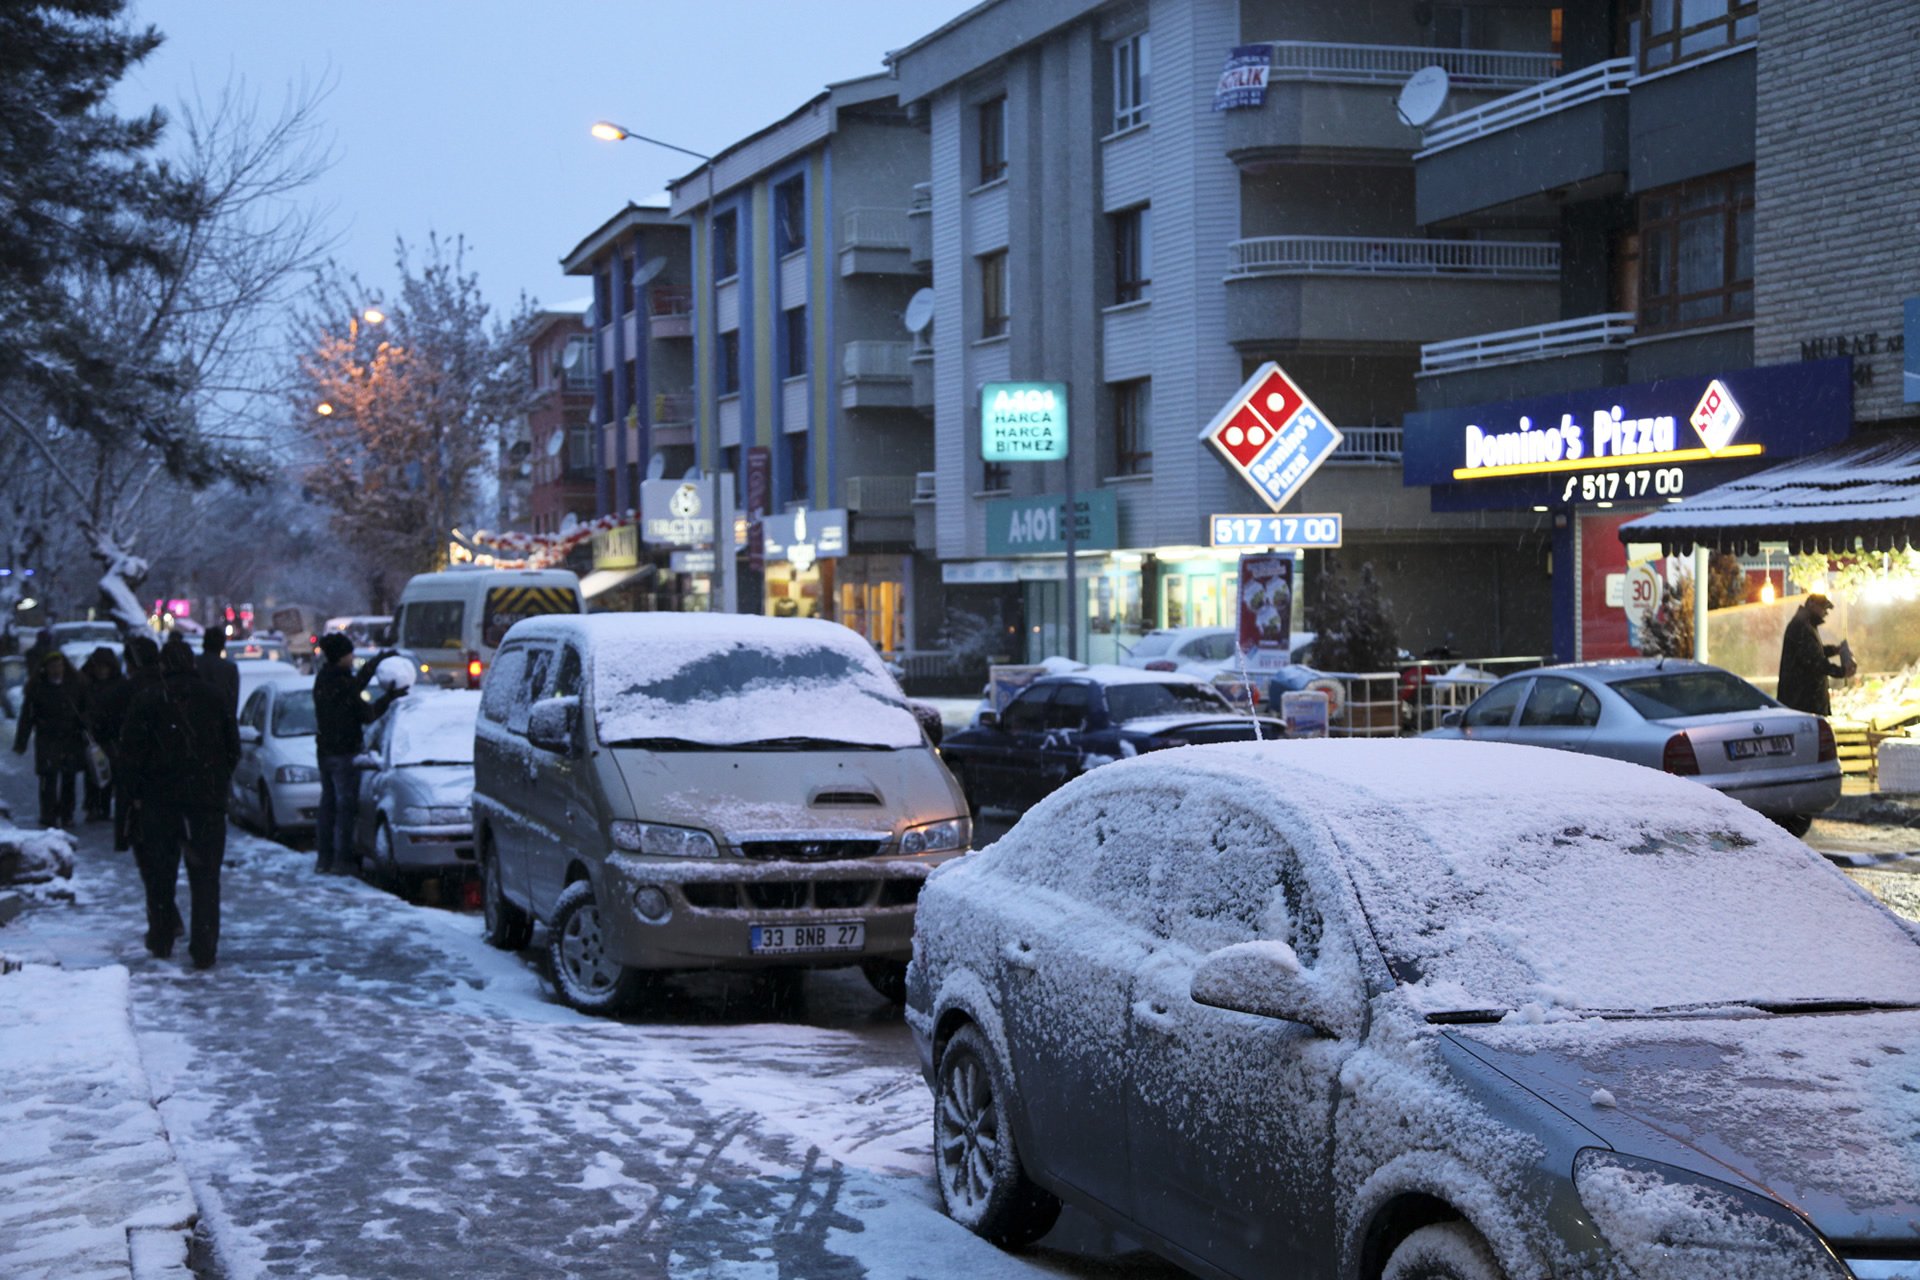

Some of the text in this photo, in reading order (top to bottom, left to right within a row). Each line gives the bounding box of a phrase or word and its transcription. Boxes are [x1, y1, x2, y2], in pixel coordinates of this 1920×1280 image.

[995, 412, 1052, 423] HARCA
[995, 427, 1052, 437] HARCA
[1465, 405, 1676, 469] Domino's Pizza
[1251, 414, 1317, 484] Domino's
[1265, 451, 1310, 498] Pizza
[1582, 469, 1684, 500] 517 17 00
[1216, 518, 1336, 543] 517 17 00
[1632, 580, 1651, 601] 30
[763, 926, 858, 947] 33 BNB 27
